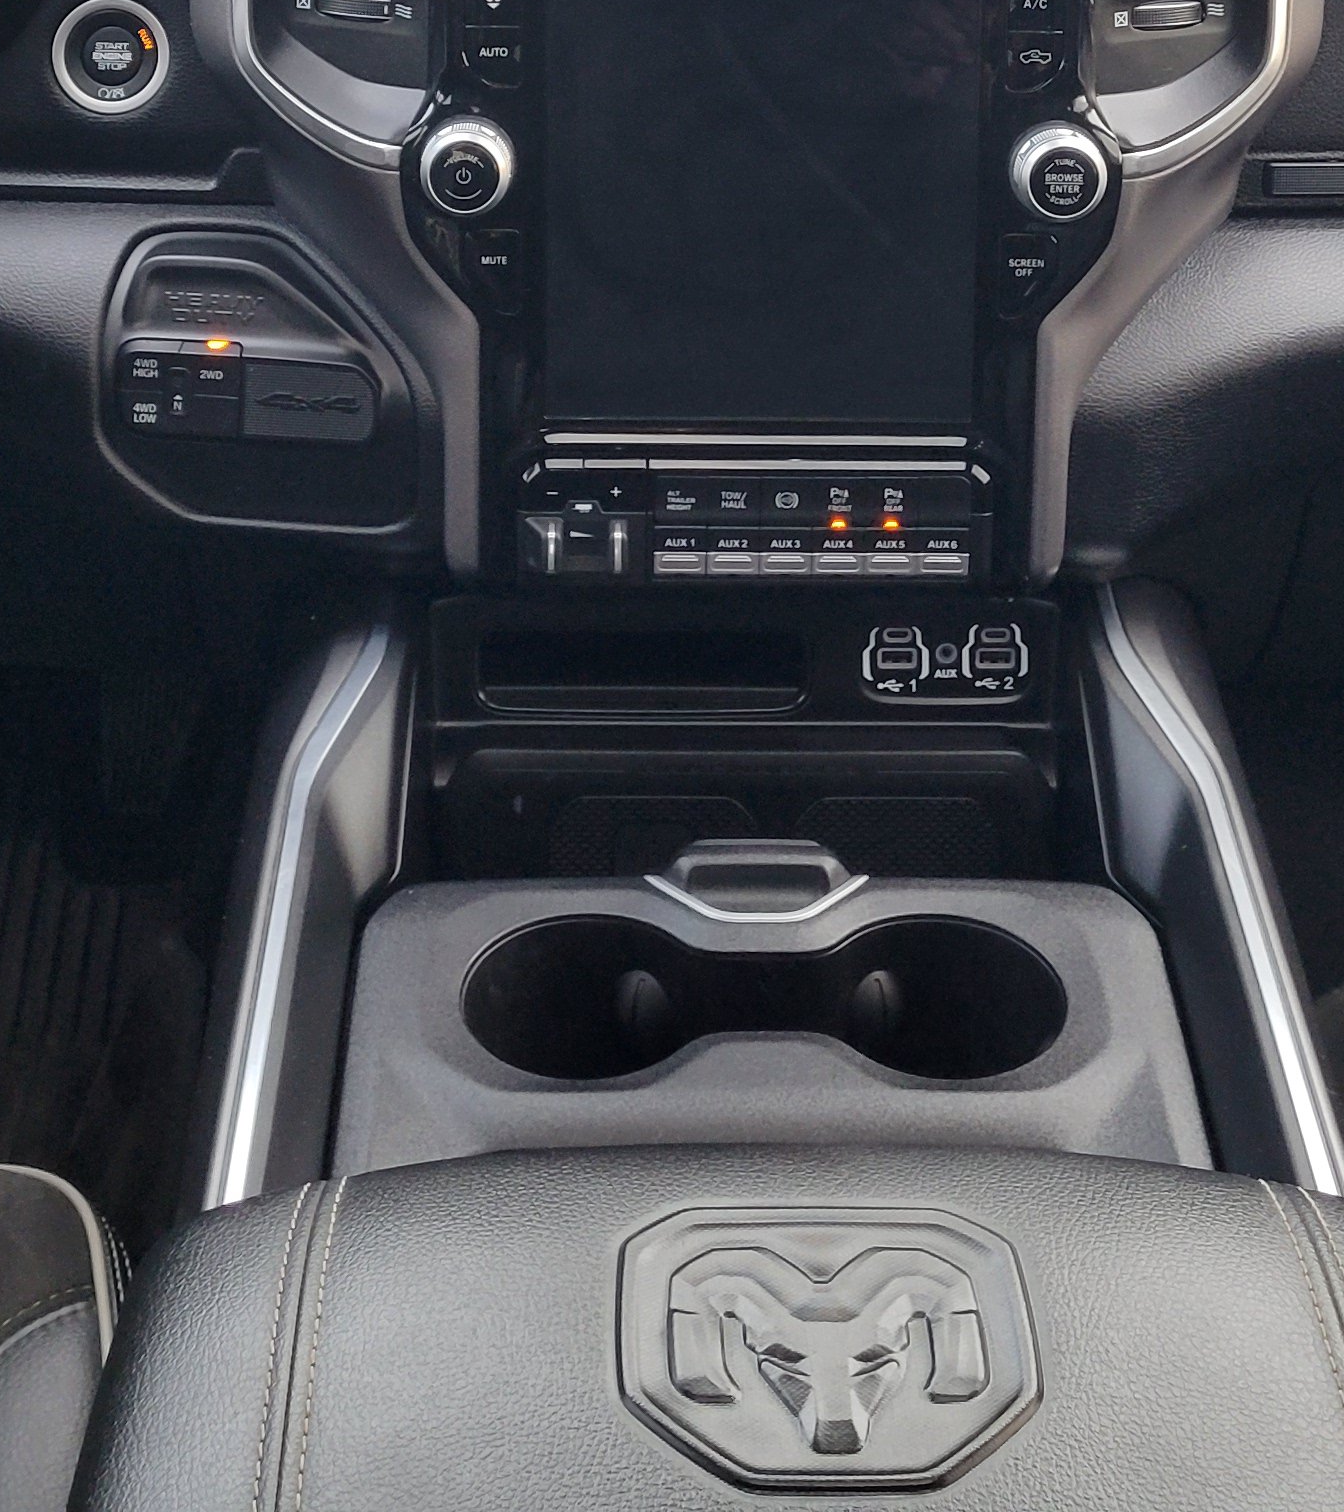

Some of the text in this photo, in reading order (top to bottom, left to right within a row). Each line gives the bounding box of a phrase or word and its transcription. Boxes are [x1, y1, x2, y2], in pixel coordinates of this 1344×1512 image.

[137, 28, 155, 51] RUN
[94, 41, 130, 50] START
[479, 46, 509, 58] AUTO
[97, 62, 128, 71] STOP
[1044, 173, 1084, 183] BROWSE
[1049, 184, 1080, 194] ENTER
[1049, 196, 1079, 206] SCROLL
[480, 255, 508, 265] MUTE
[1008, 258, 1045, 268] SCREEN
[1014, 268, 1033, 277] OFF
[133, 358, 158, 369] 4WD
[132, 368, 159, 379] HIGH
[199, 369, 224, 381] 2WD
[132, 402, 157, 413] 4WD
[173, 400, 183, 412] N
[133, 412, 157, 424] LOW
[720, 491, 747, 502] TOW/
[720, 500, 747, 510] HAUL
[933, 668, 958, 679] AUX
[908, 678, 917, 693] 1
[1003, 676, 1015, 690] 2
